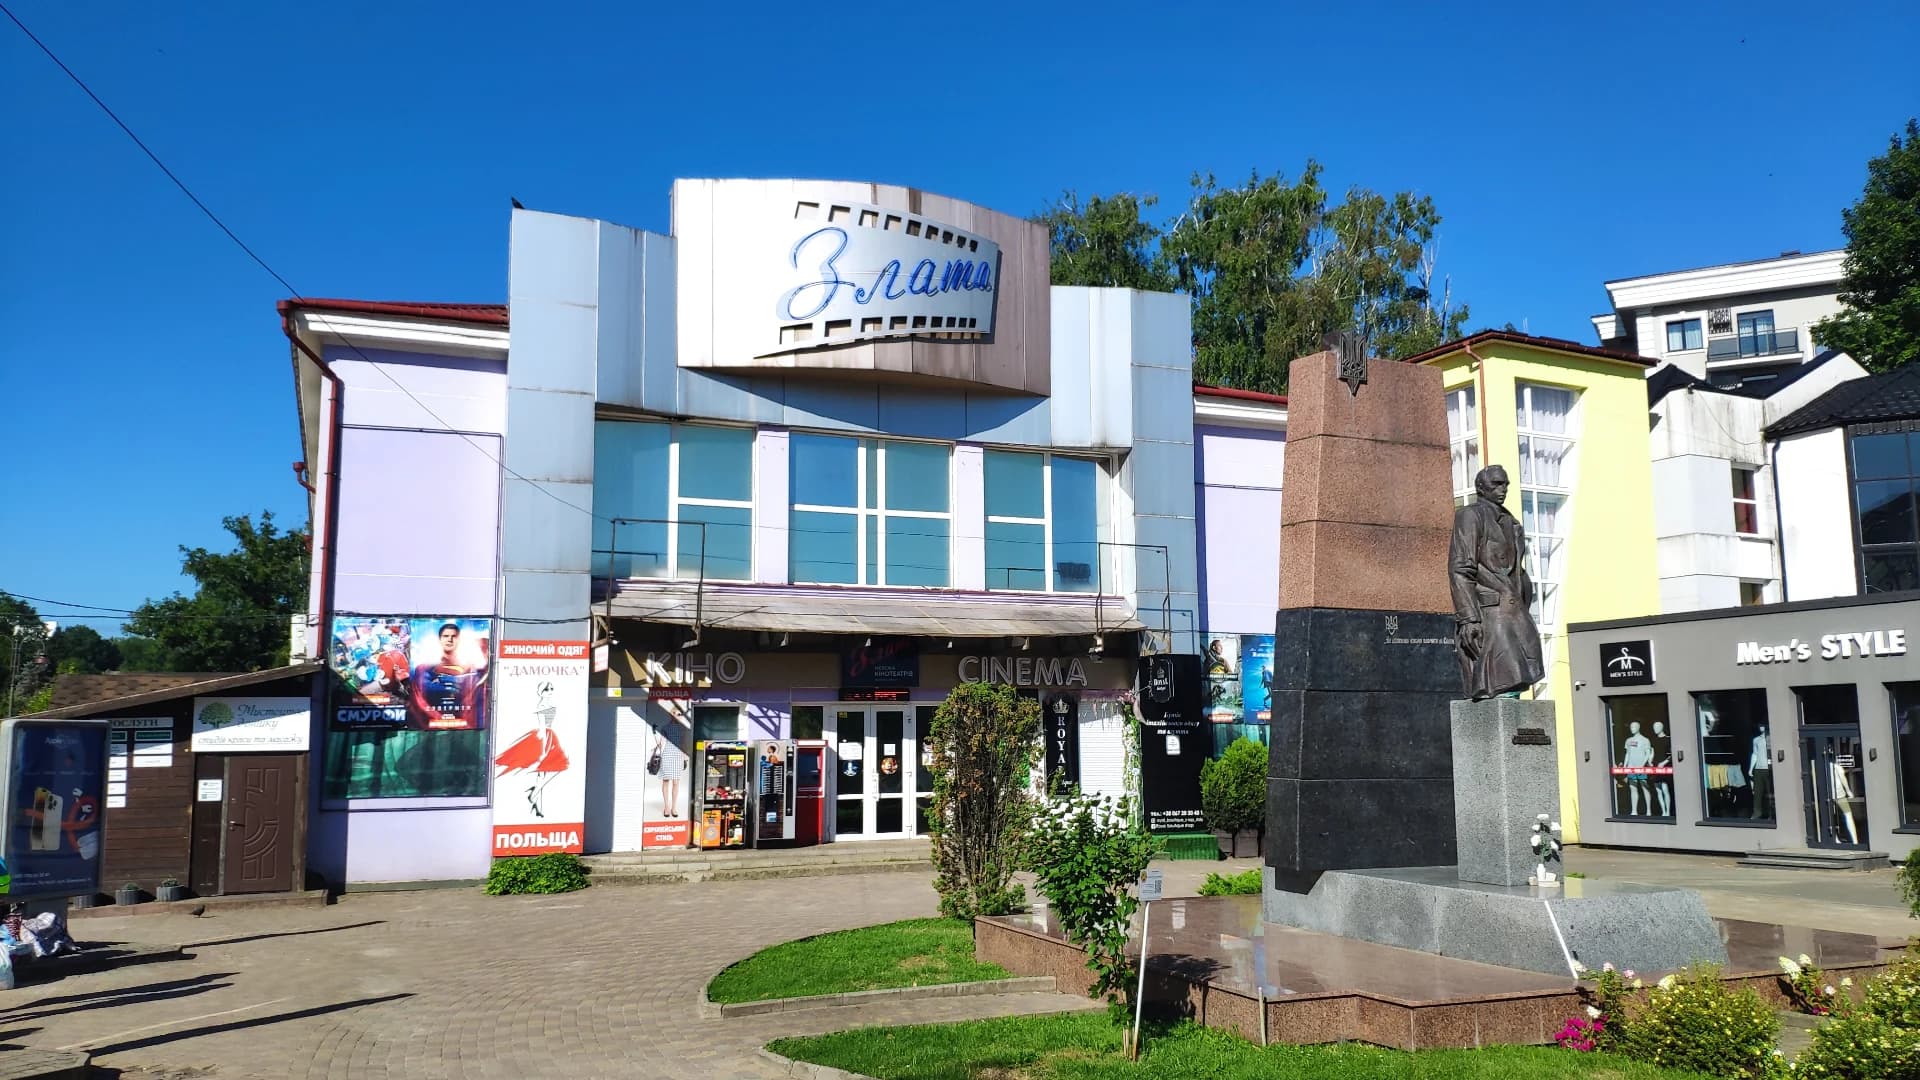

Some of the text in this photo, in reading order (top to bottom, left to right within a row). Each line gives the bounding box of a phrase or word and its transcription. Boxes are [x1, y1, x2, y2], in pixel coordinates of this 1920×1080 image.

[780, 226, 993, 320] Злата
[504, 644, 586, 656] ЖІНОЧИЙ ОДЯГ
[1737, 630, 1907, 665] Men's STYLE
[644, 652, 746, 684] КІНО
[958, 655, 1088, 687] CINEMA
[112, 719, 159, 727] ОСЛУГИ
[337, 709, 406, 722] СМУРФИ
[496, 832, 580, 849] ПОЛЬЩА
